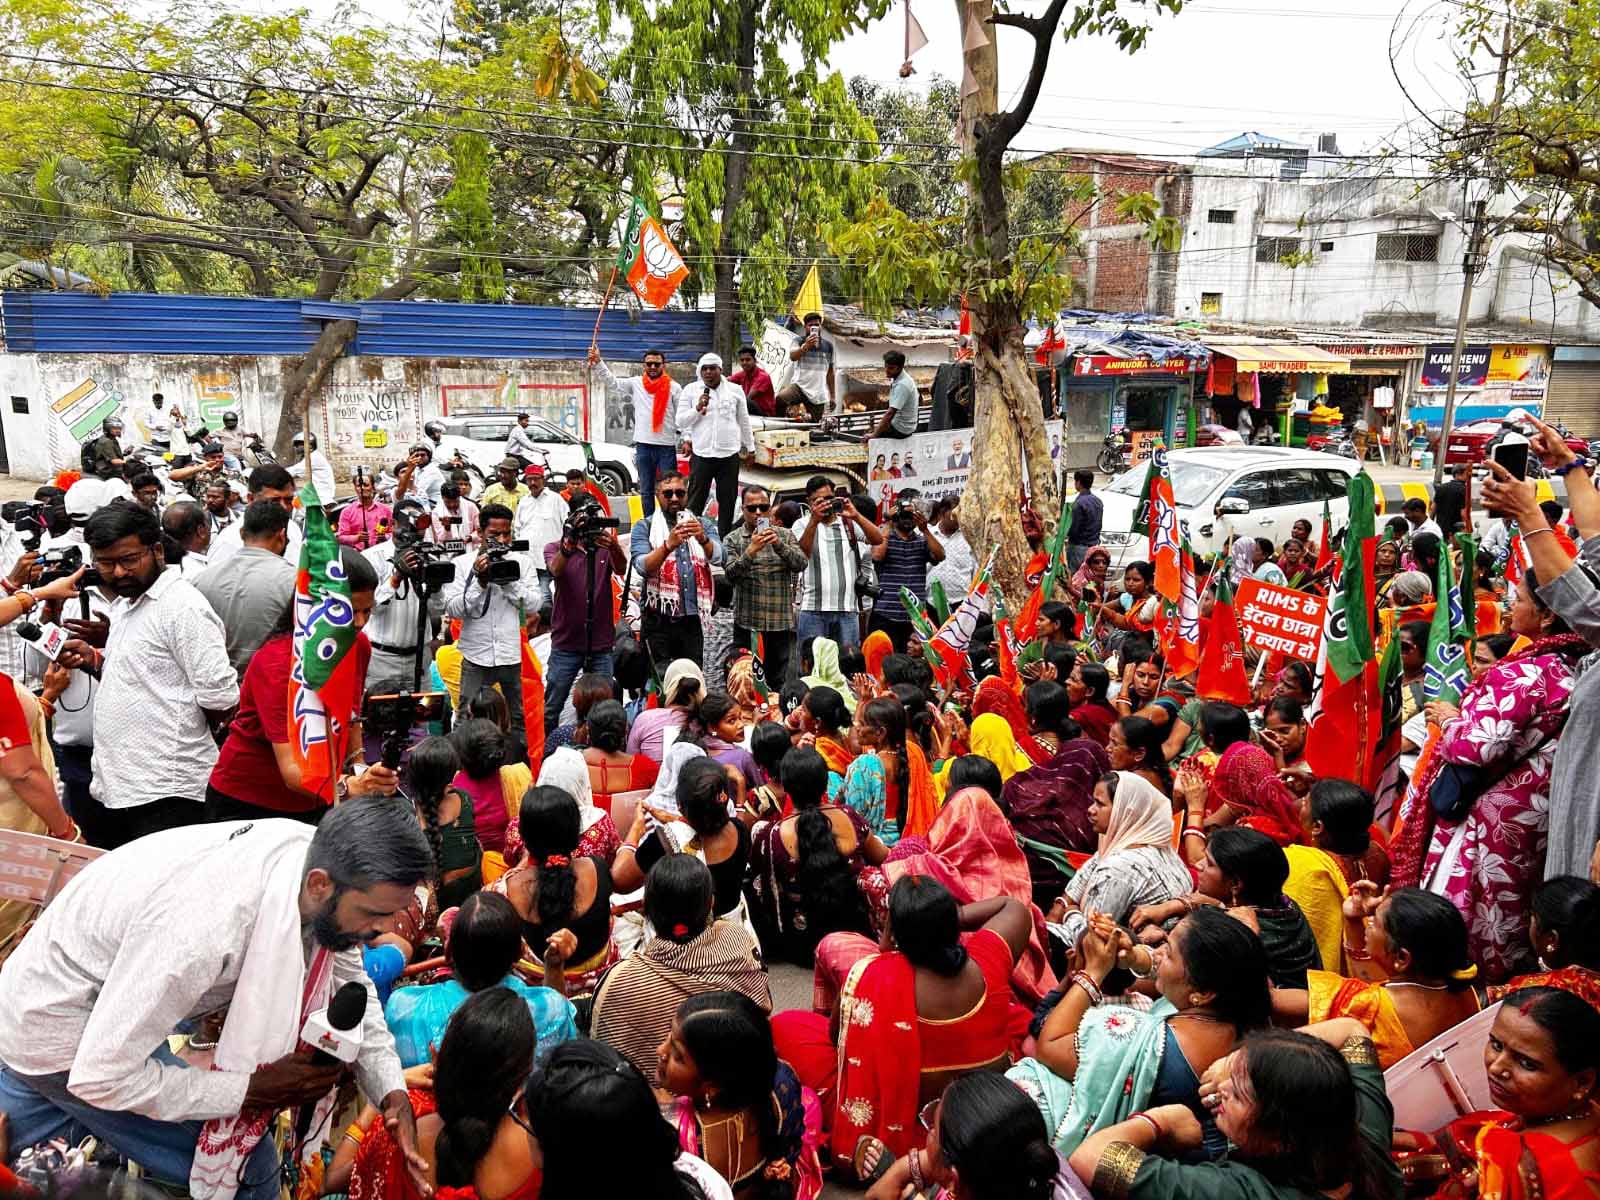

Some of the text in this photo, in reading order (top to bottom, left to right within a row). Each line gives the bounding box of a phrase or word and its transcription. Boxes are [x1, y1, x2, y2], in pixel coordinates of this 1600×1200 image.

[1334, 344, 1376, 355] HARDWAE
[1385, 344, 1415, 355] PAINTS
[1105, 360, 1148, 369] ANIRUDRA
[1430, 354, 1486, 364] KAMHENU
[1259, 361, 1276, 370] SAHU
[1280, 361, 1307, 370] TRADERS
[1441, 365, 1471, 373] PATS
[368, 391, 411, 410] VOTE
[361, 410, 399, 423] VOICE!
[337, 432, 352, 442] 25
[1256, 588, 1321, 615] RIMS के
[1242, 603, 1281, 628] डेंटल
[1282, 617, 1320, 638] छात्रा
[1255, 632, 1297, 654] न्याय
[1297, 641, 1316, 659] दो
